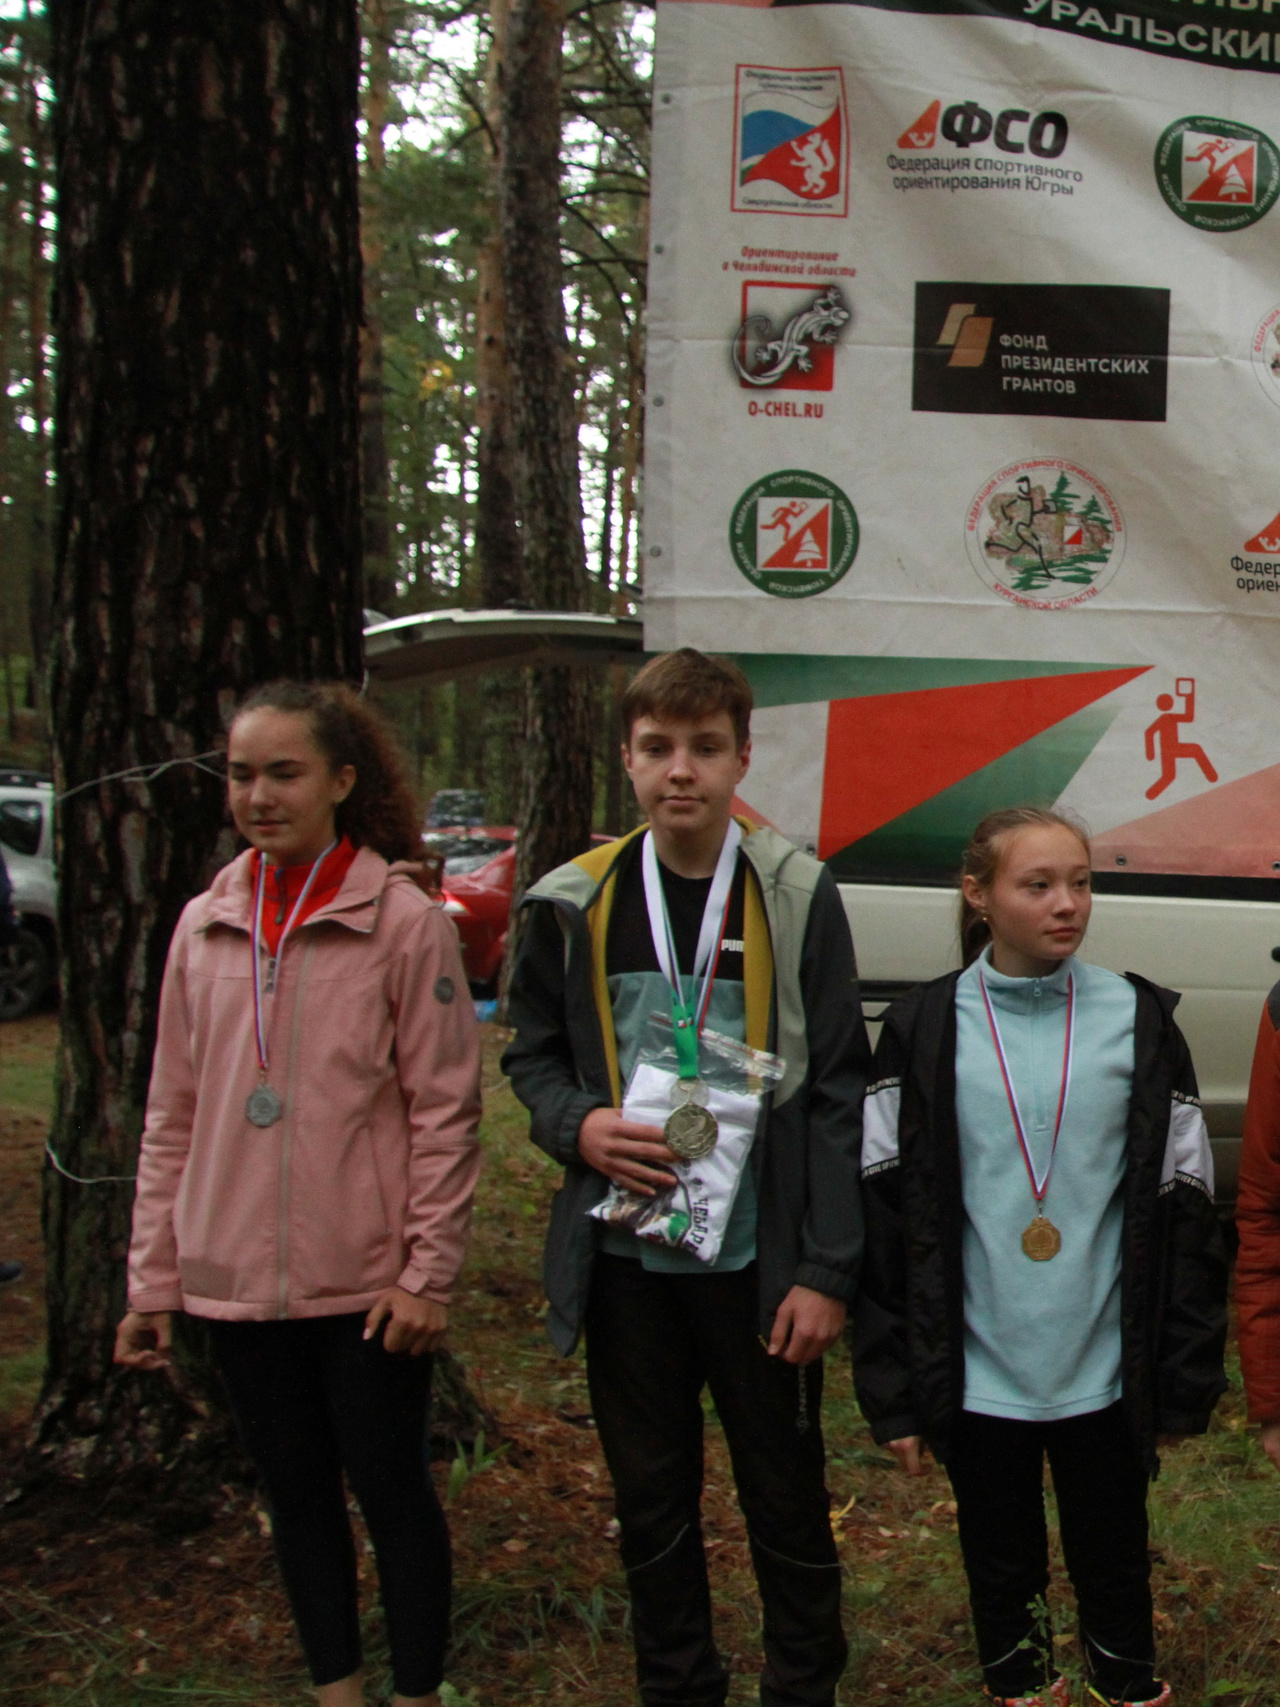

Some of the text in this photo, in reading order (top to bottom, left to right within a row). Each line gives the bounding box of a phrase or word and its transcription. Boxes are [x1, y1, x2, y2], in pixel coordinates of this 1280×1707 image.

[941, 100, 1068, 159] ФСО
[999, 333, 1049, 351] ФОНД
[1001, 354, 1149, 374] ПРЕЗИДЕНТСКИХ
[1002, 376, 1076, 394] ГРАНТОВ
[748, 401, 824, 418] O-CHEL.RU
[721, 938, 745, 953] PUM
